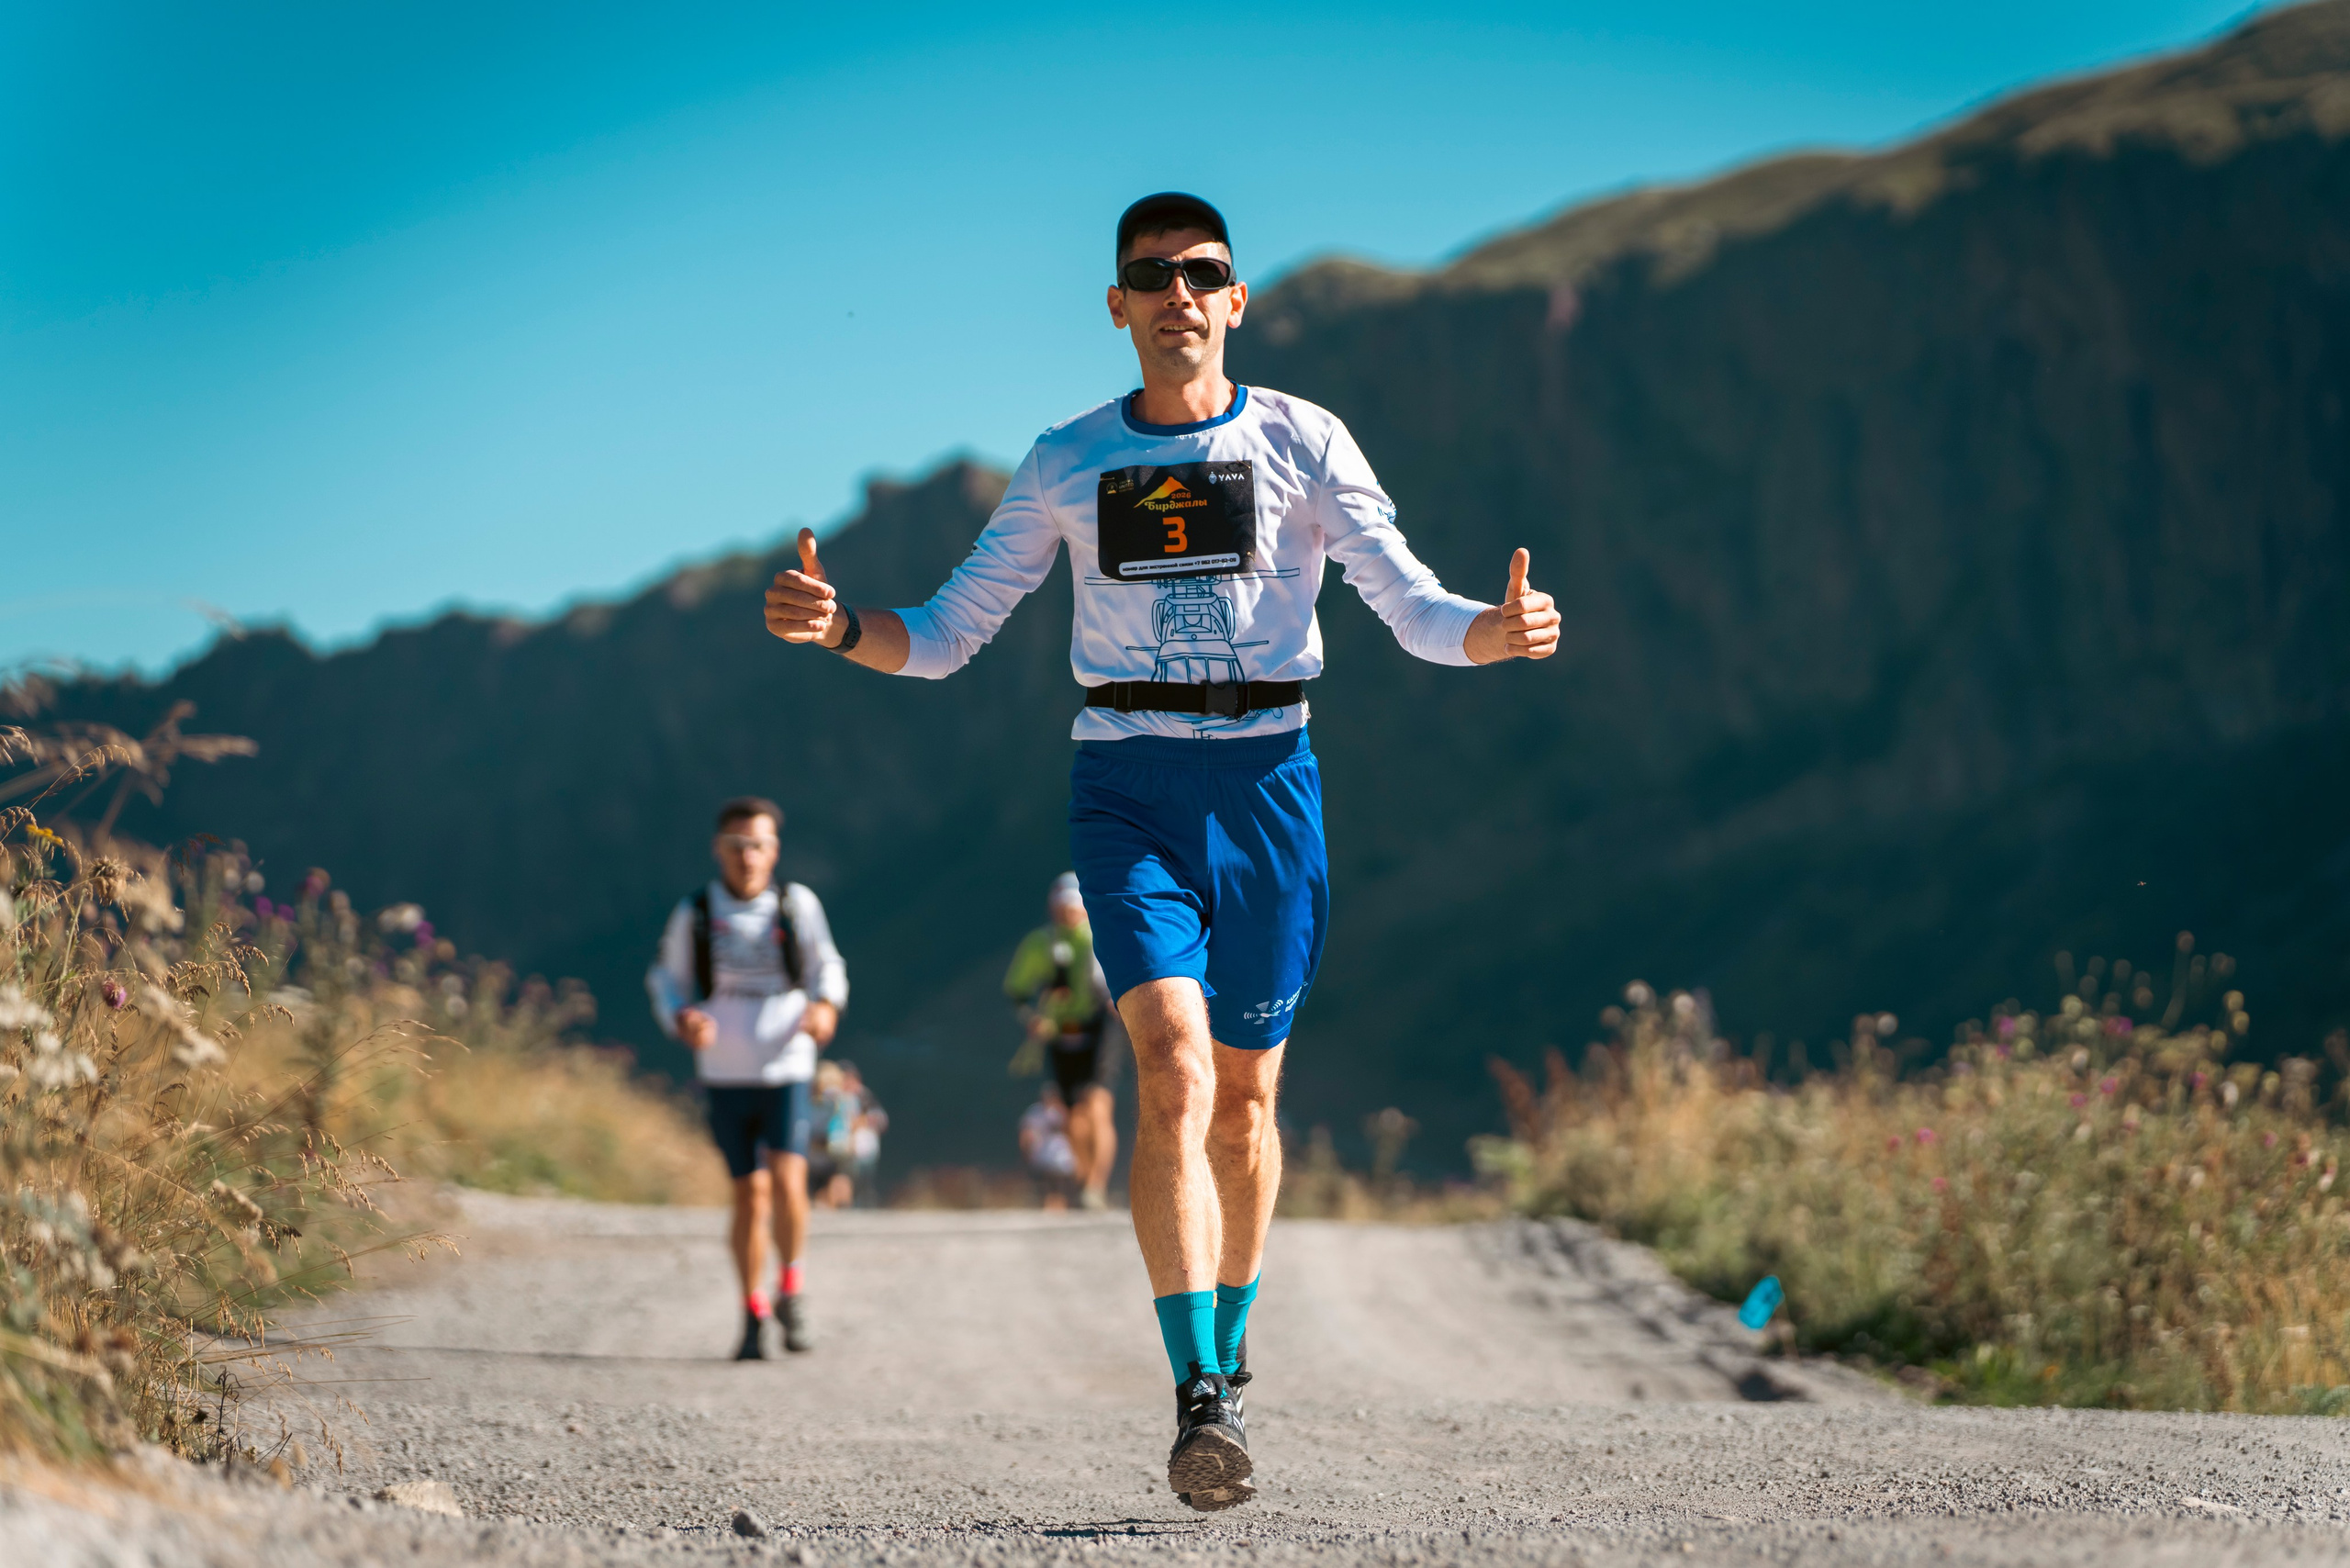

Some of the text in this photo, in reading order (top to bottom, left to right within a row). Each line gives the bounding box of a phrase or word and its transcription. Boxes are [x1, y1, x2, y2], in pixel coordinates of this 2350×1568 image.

[1218, 473, 1245, 482] YAVA
[1144, 499, 1207, 512] Бирджалы
[1162, 516, 1188, 553] 3
